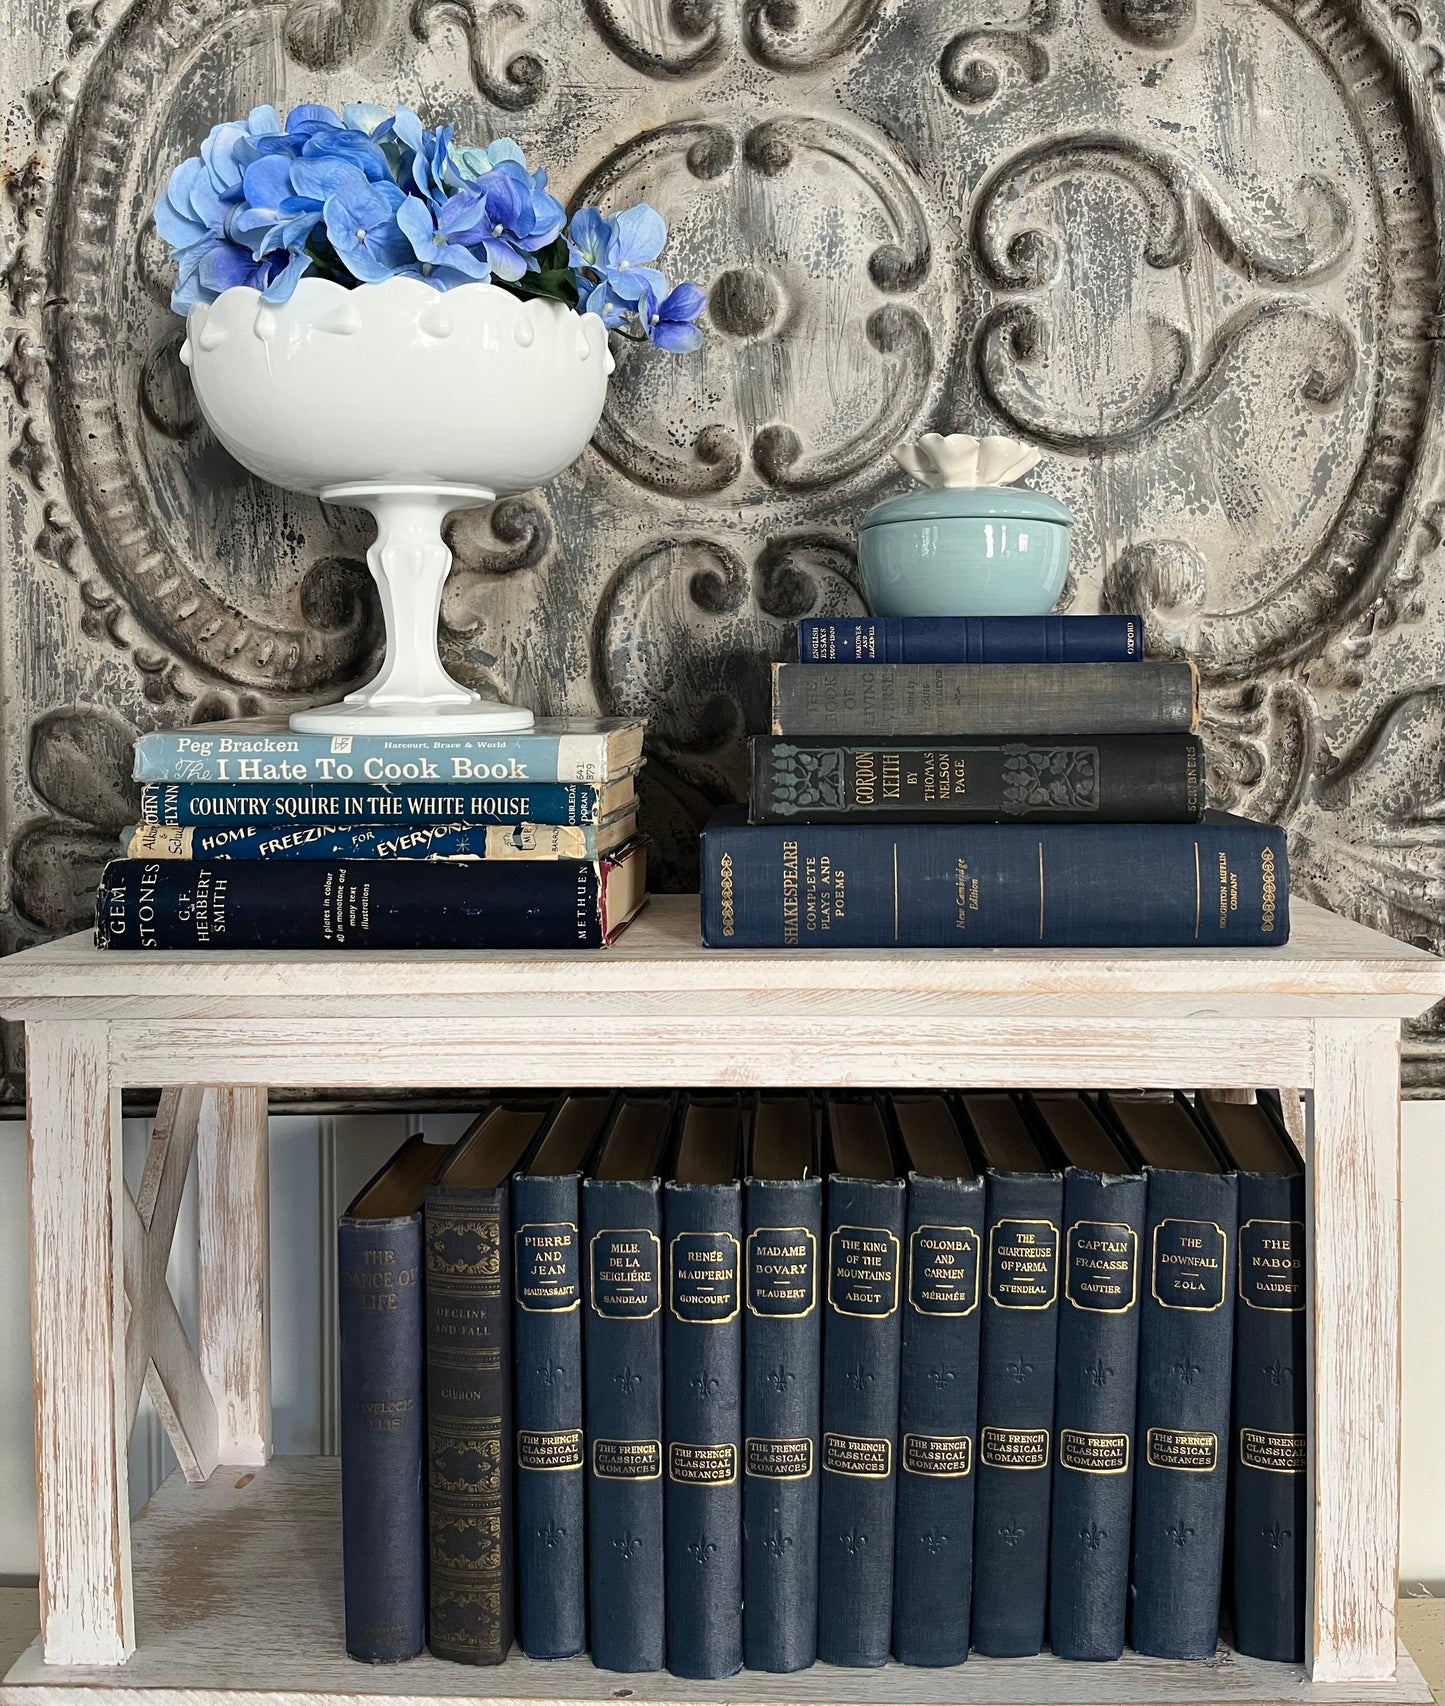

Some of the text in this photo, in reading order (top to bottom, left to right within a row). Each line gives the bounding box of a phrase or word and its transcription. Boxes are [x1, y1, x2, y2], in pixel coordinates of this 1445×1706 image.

[843, 688, 857, 710] OF
[176, 738, 300, 757] Peg Bracken
[384, 741, 506, 750] Harcourt, Brace & World
[173, 758, 529, 781] The I Hate To Cook Book
[576, 763, 585, 781] 641
[586, 763, 595, 780] B79
[855, 752, 875, 806] GORDON
[883, 753, 900, 799] KEITH
[906, 771, 918, 785] BY
[925, 752, 935, 801] THOMAS
[939, 753, 950, 800] NELSON
[955, 759, 965, 794] PAGE
[165, 785, 179, 826] FLYNN
[190, 797, 530, 816] COUNTRY SQUIRE IN THE WHITE HOUSE
[202, 826, 256, 850] HOME
[352, 831, 375, 844] FOR
[324, 872, 333, 896] colour
[783, 841, 798, 945] SHAKESPEARE
[806, 856, 816, 931] COMPLETE
[820, 856, 830, 930] PLAYS AND
[835, 870, 845, 917] POEMS
[955, 858, 967, 929] New Cambridge
[969, 878, 979, 910] Edition
[1219, 852, 1228, 929] HOUGHTON MIFFLIN
[1230, 872, 1238, 911] COMPANY
[139, 863, 160, 947] STONES
[196, 869, 212, 942] HERBERT
[214, 879, 228, 932] SMITH
[323, 898, 330, 907] in
[336, 868, 347, 943] 40 in monotone and
[349, 886, 358, 927] many text
[361, 883, 370, 930] illustrations
[577, 866, 588, 939] METHUEN
[323, 909, 333, 933] plates
[524, 1235, 572, 1248] PIERRE
[920, 1239, 971, 1251] COLOMBA
[1016, 1234, 1035, 1244] THE
[1179, 1237, 1202, 1249] THE
[1262, 1240, 1291, 1249] THE
[611, 1244, 640, 1254] MLLE.
[756, 1246, 807, 1257] MADAME
[841, 1239, 887, 1252] THE KING
[1077, 1239, 1128, 1252] CAPTAIN
[534, 1251, 562, 1262] AND
[687, 1250, 724, 1262] RENÉE
[997, 1246, 1052, 1258] CHARTREUSE
[609, 1257, 641, 1268] DE LA
[846, 1255, 882, 1266] OF THE
[935, 1255, 955, 1264] AND
[1075, 1258, 1129, 1270] FRACASSE
[1162, 1254, 1218, 1268] DOWNFALL
[1252, 1257, 1301, 1268] NABOB
[530, 1264, 566, 1275] JEAN
[755, 1264, 808, 1275] BOVARY
[1001, 1260, 1048, 1272] OF PARMA
[678, 1269, 733, 1280] MAUPERIN
[836, 1267, 892, 1282] MOUNTAINS
[924, 1268, 964, 1279] CARMEN
[523, 1285, 575, 1297] MAUPASSANT
[999, 1284, 1046, 1294] STENDHAL
[1080, 1283, 1121, 1294] GAUTIER
[1174, 1280, 1206, 1291] ZOLA
[1256, 1282, 1299, 1292] DAUDET
[603, 1295, 648, 1304] SANDEAU
[679, 1294, 731, 1304] GONCOURT
[756, 1289, 807, 1299] FLAUBERT
[845, 1292, 881, 1303] ABOUT
[921, 1289, 966, 1301] MÉRIMÉE
[436, 1308, 487, 1319] DECLINE
[461, 1325, 491, 1336] FALL
[523, 1434, 578, 1444] THE FRENCH
[987, 1432, 1045, 1443] THE FRENCH
[1067, 1434, 1124, 1447] THE FRENCH
[1154, 1433, 1213, 1446] THE FRENCH
[1246, 1433, 1266, 1444] THE
[522, 1444, 578, 1454] CLASSICAL
[599, 1445, 656, 1454] THE FRENCH
[750, 1443, 807, 1453] THE FRENCH
[828, 1438, 885, 1452] THE FRENCH
[909, 1439, 966, 1450] THE FRENCH
[987, 1443, 1043, 1453] CLASSICAL
[1067, 1444, 1123, 1457] CLASSICAL
[1154, 1443, 1212, 1455] CLASSICAL
[1246, 1443, 1306, 1457] CLASSICAL
[523, 1454, 578, 1464] ROMANCES
[599, 1455, 655, 1463] CLASSICAL
[675, 1448, 731, 1459] THE FRENCH
[750, 1453, 806, 1462] CLASSICAL
[828, 1449, 884, 1462] CLASSICAL
[909, 1449, 965, 1460] CLASSICAL
[987, 1452, 1043, 1463] ROMANCES
[1153, 1452, 1212, 1465] ROMANCES
[675, 1459, 730, 1468] CLASSICAL
[828, 1459, 885, 1471] ROMANCES
[909, 1459, 965, 1469] ROMANCES
[1067, 1454, 1123, 1467] ROMANCES
[599, 1464, 656, 1473] ROMANCES
[675, 1468, 731, 1479] ROMANCES
[750, 1463, 807, 1472] ROMANCES
